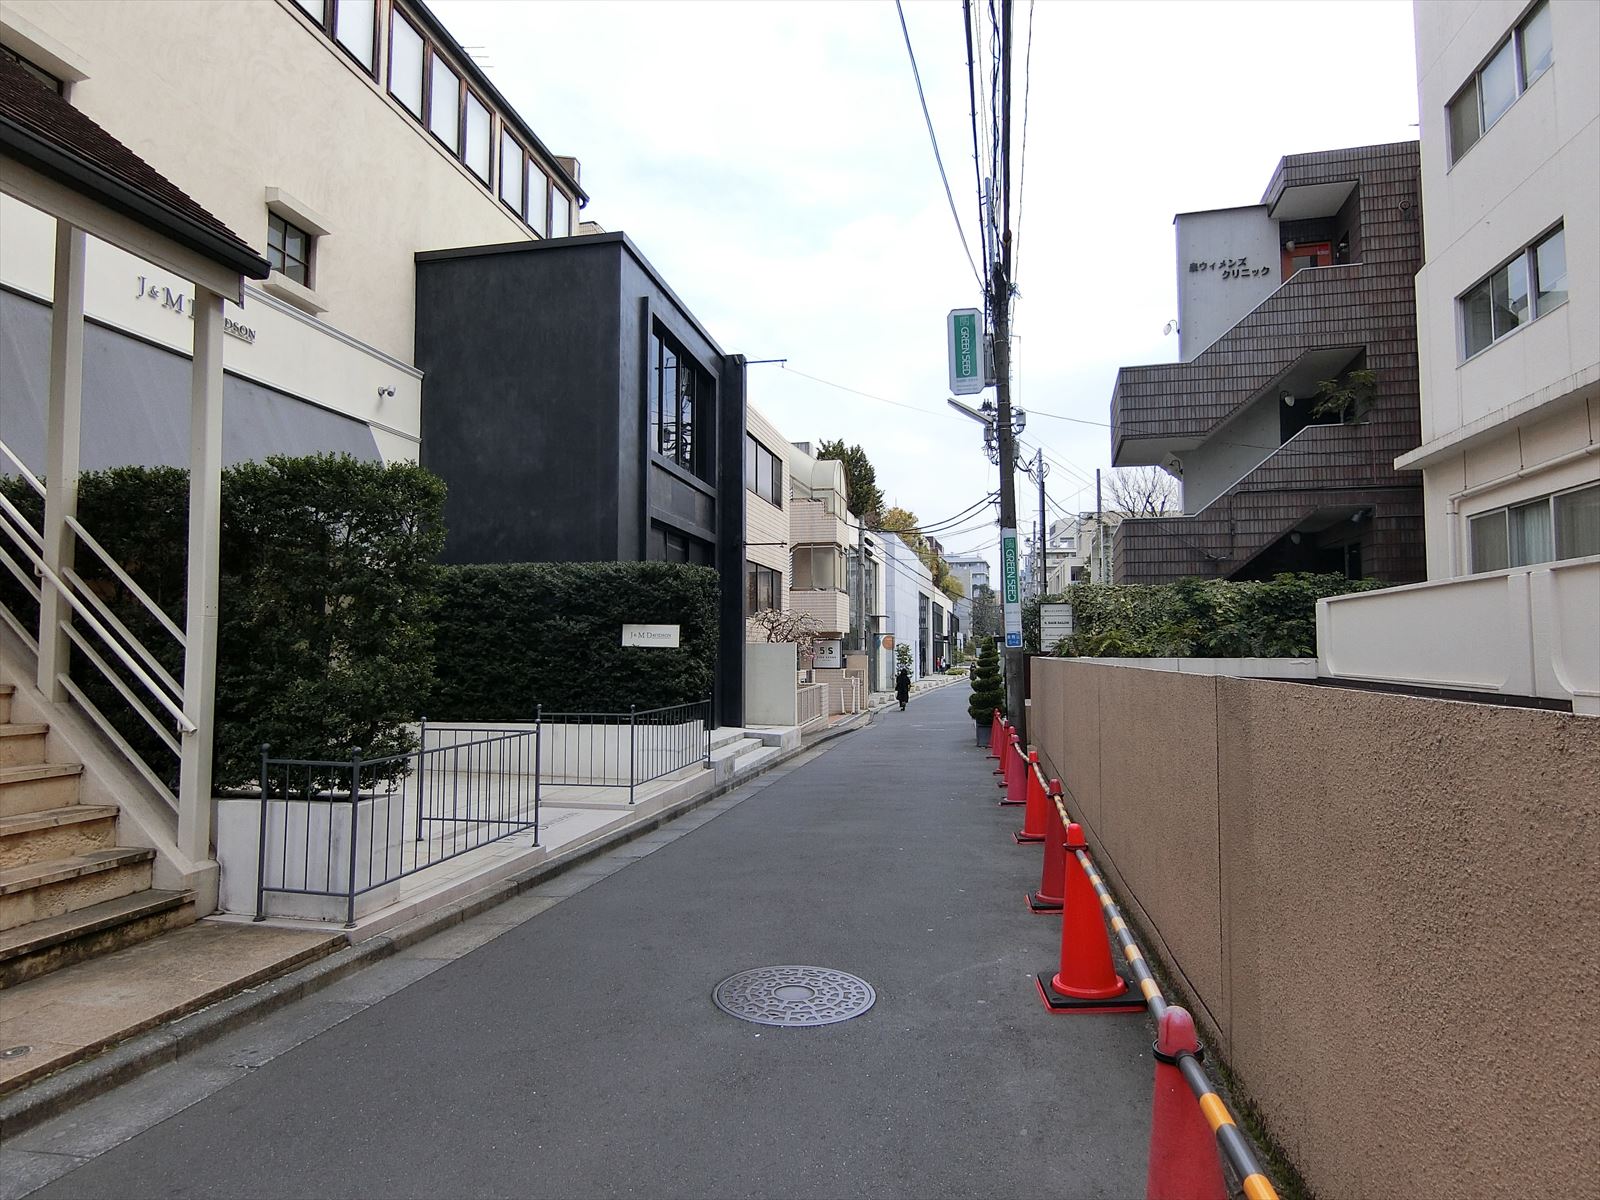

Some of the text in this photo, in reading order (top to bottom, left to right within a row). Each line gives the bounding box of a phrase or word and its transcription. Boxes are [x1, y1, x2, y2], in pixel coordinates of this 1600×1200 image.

[1222, 266, 1270, 280] クリニック
[960, 326, 971, 354] GREEN
[962, 354, 971, 377] SEED
[1005, 549, 1016, 578] GREEN
[1006, 579, 1017, 602] SEED
